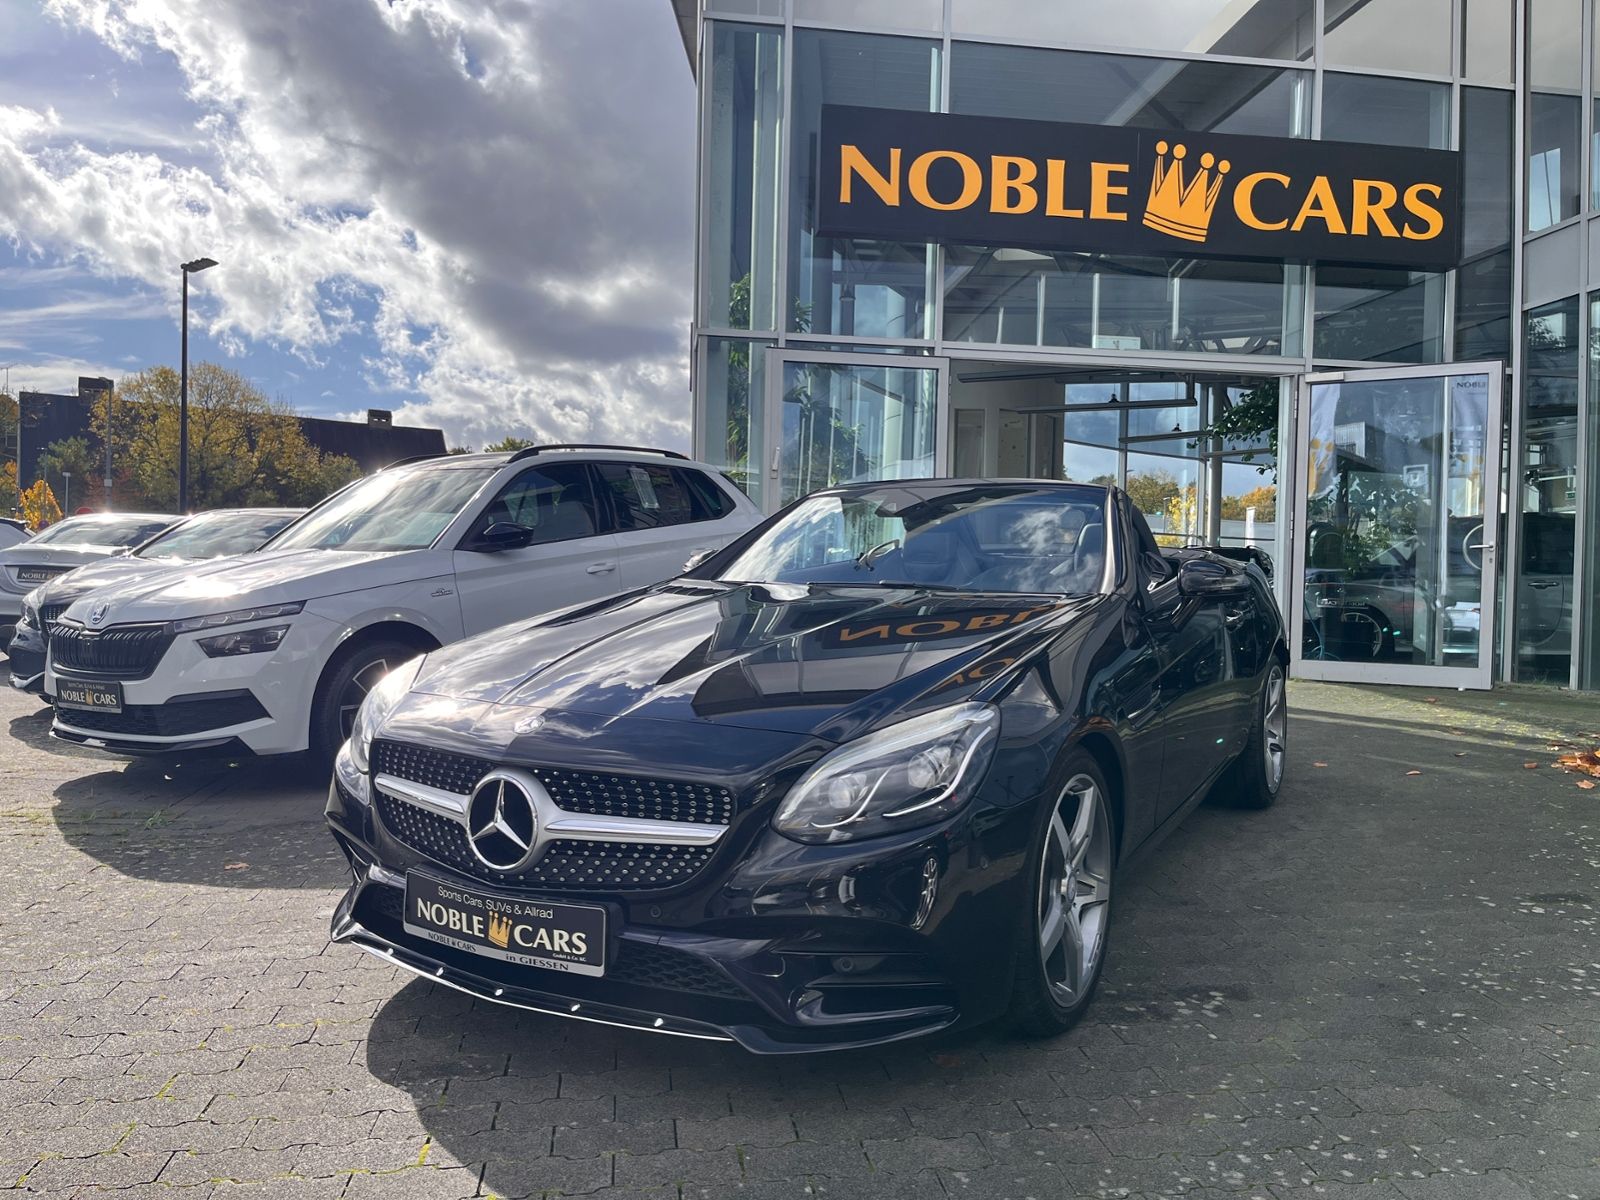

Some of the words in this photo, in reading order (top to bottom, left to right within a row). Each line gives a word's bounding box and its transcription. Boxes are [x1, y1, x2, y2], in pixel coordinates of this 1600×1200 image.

[839, 143, 1131, 221] NOBLE
[1232, 171, 1445, 242] CARS
[61, 689, 86, 703] NOBLE
[93, 692, 117, 705] CARS
[438, 886, 462, 902] Sports
[463, 894, 485, 909] Cars,
[486, 899, 512, 913] SUVs
[513, 905, 522, 915] &
[523, 906, 554, 919] Allrad
[417, 897, 485, 938] NOBLE
[513, 924, 588, 955] CARS
[428, 932, 450, 946] NOBLE
[456, 941, 477, 953] CARS
[506, 953, 516, 962] in
[519, 956, 569, 971] GIESSEN
